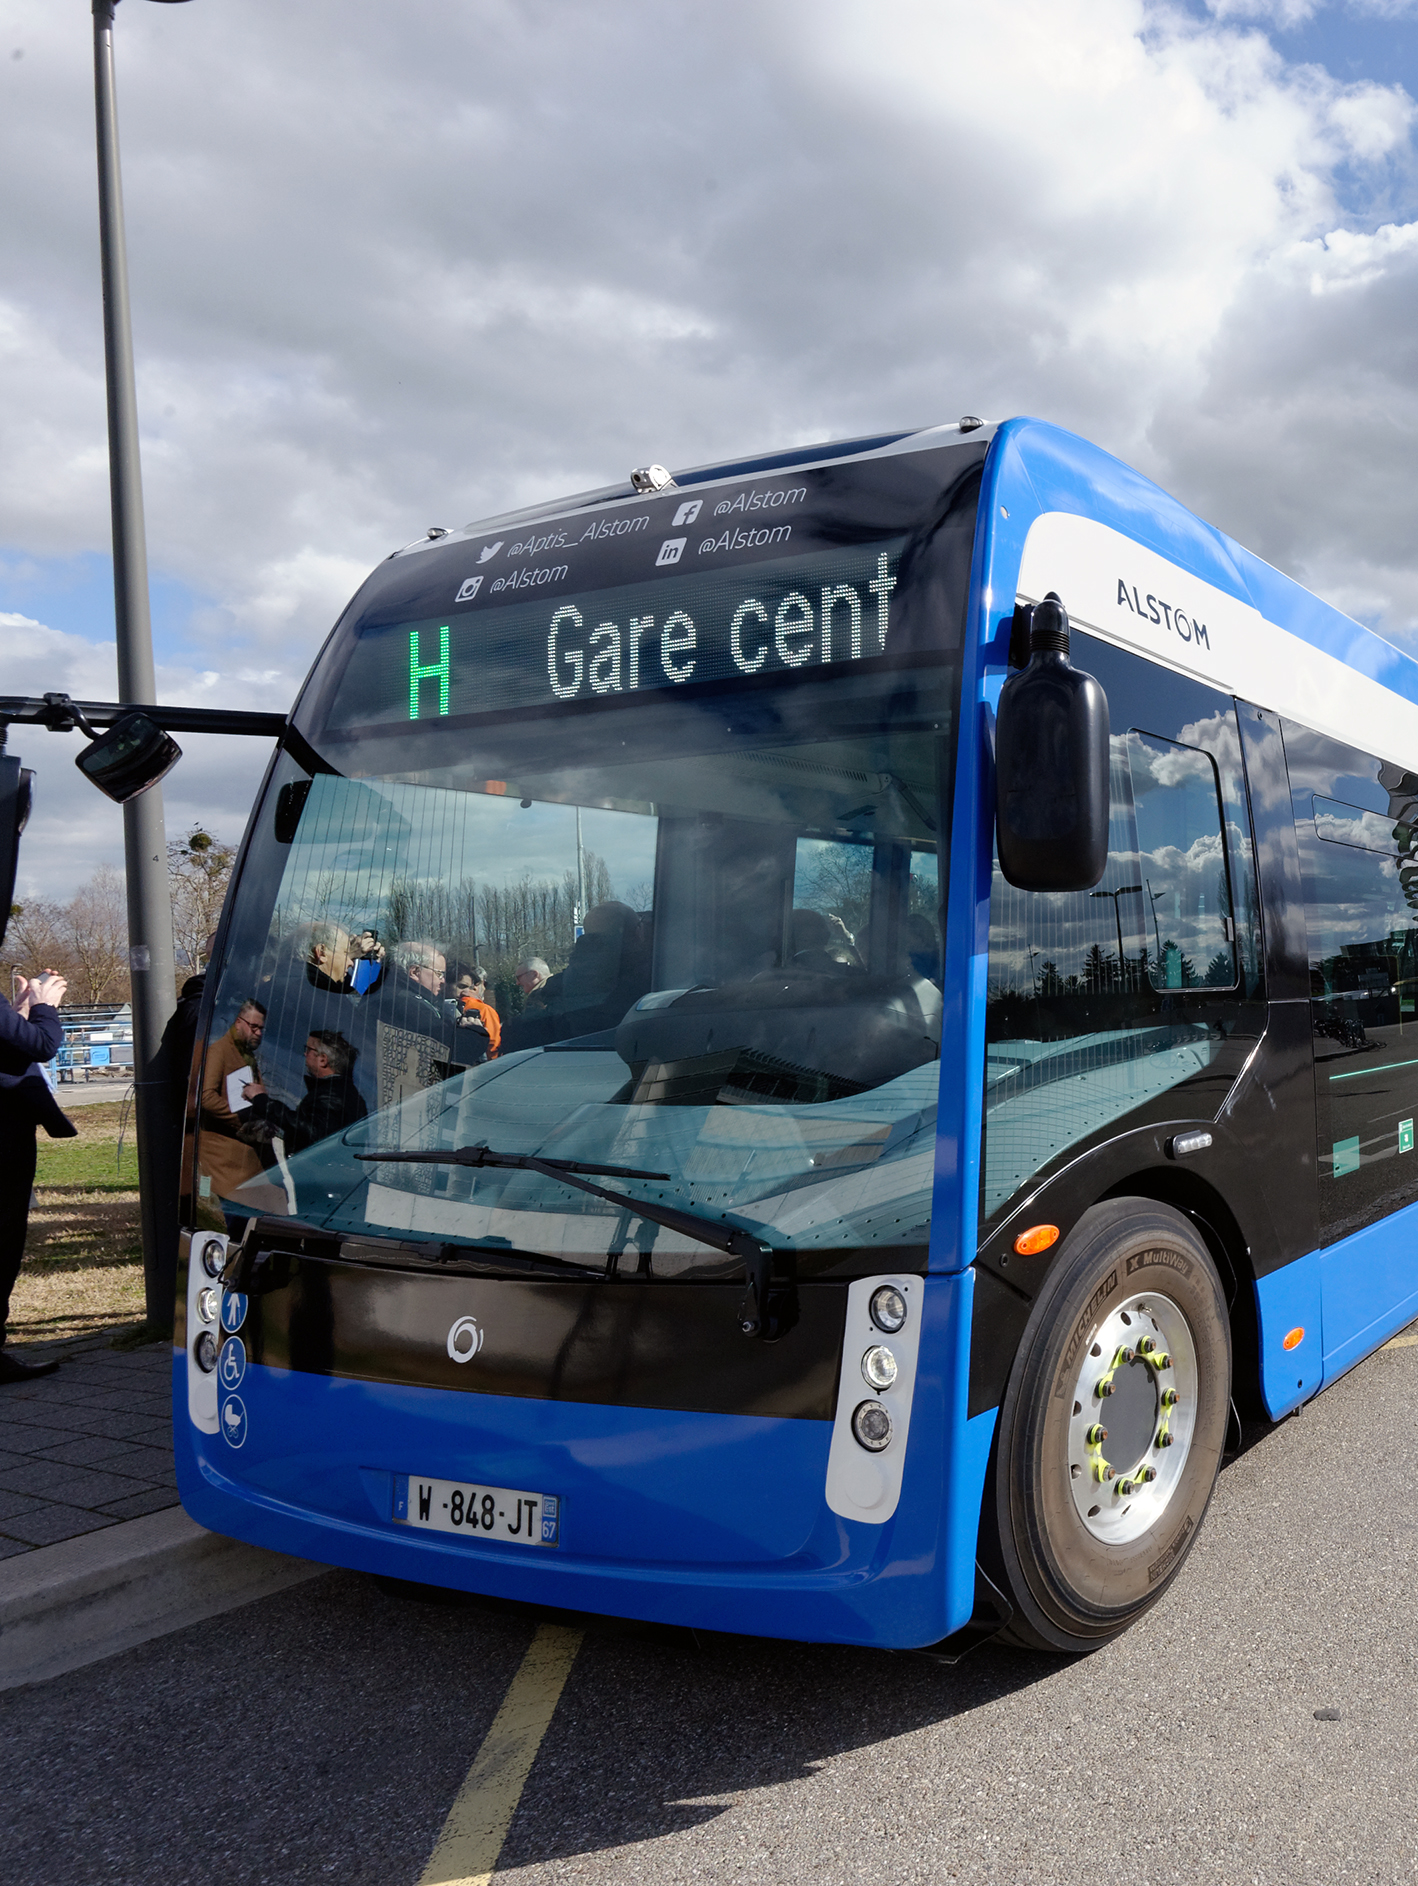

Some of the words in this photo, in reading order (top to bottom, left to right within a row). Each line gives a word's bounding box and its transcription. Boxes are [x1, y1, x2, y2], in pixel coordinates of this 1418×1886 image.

[713, 487, 807, 516] @Alstom
[507, 515, 650, 557] @Aptis_Alstom
[698, 525, 792, 555] @Alstom
[489, 564, 569, 594] @Alstom
[1117, 578, 1211, 651] ALSTOM
[410, 625, 450, 720] H
[547, 604, 697, 699] Gare
[730, 552, 898, 674] cent
[1143, 1251, 1189, 1274] MultiWay
[1066, 1270, 1118, 1364] MICHELIN
[542, 1521, 556, 1539] 67
